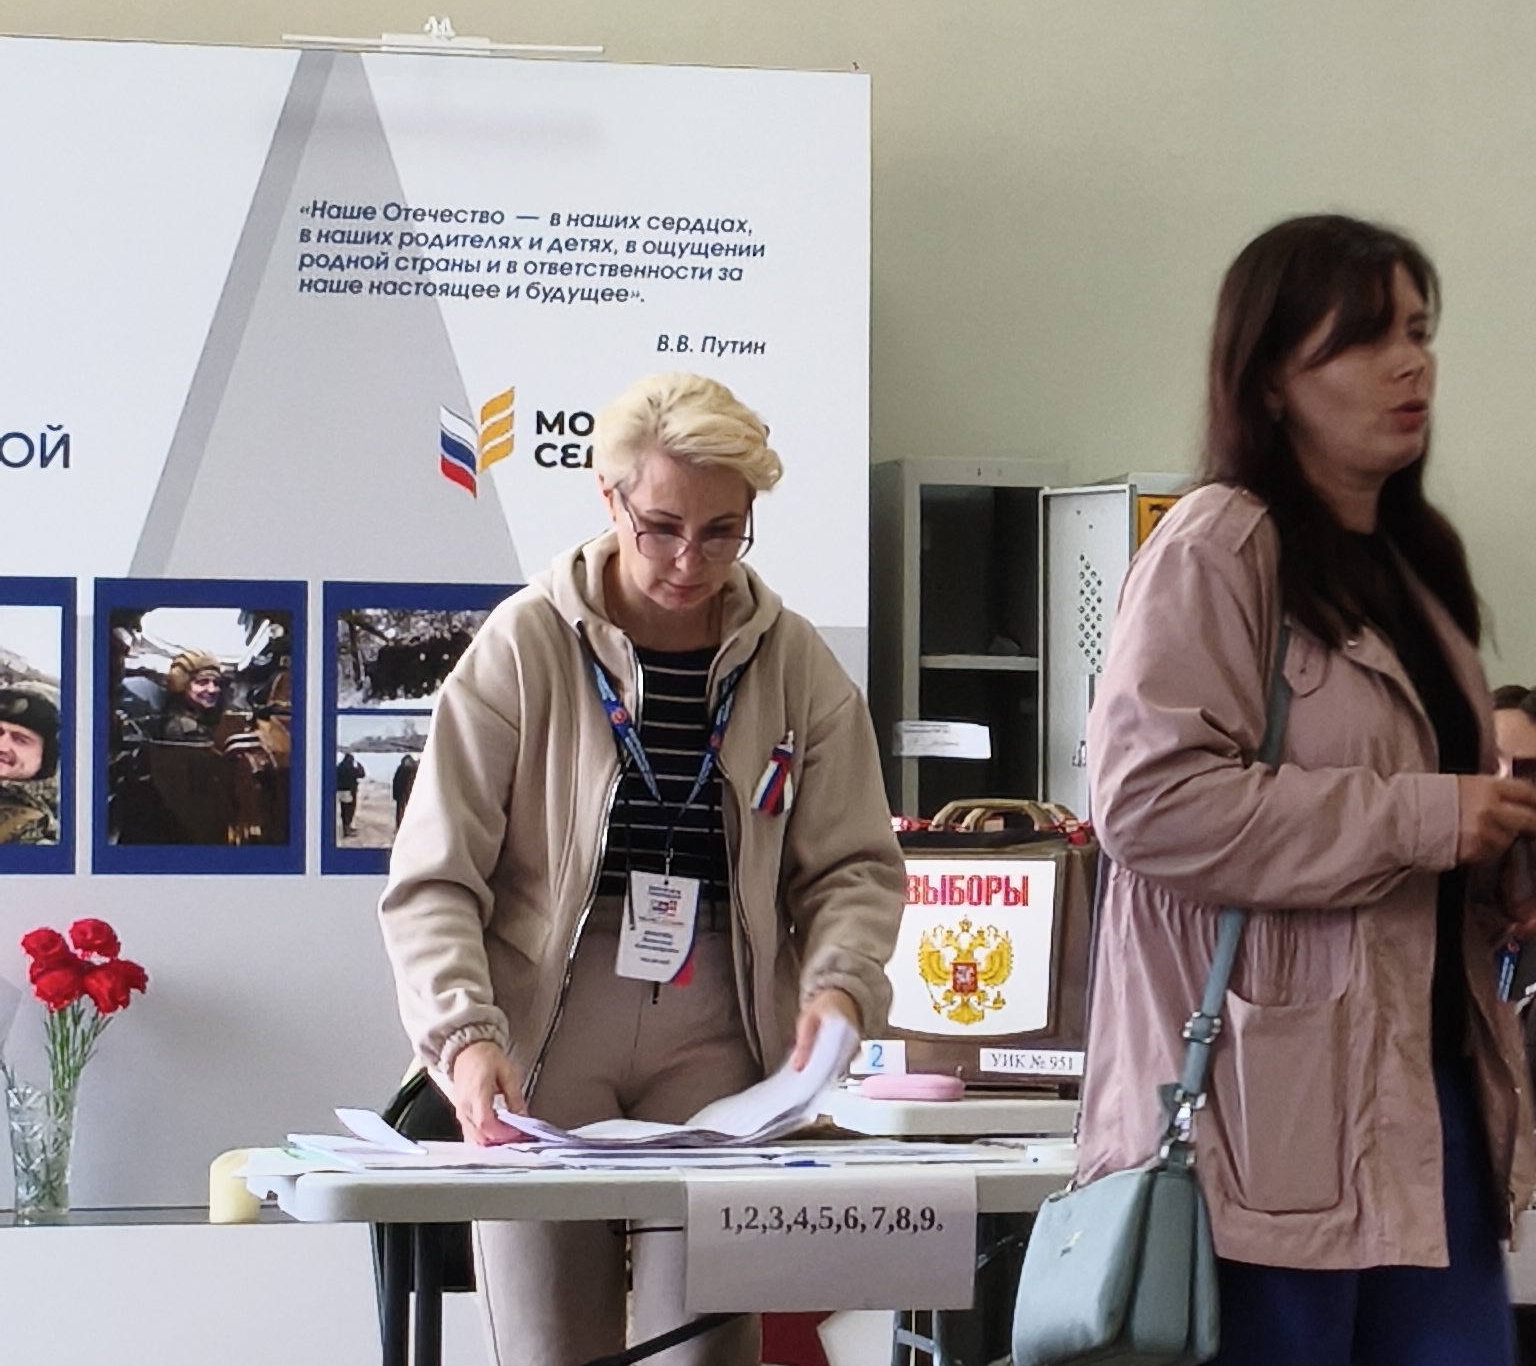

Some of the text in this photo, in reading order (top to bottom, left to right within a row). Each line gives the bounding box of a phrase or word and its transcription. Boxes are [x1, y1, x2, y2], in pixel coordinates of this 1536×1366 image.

[299, 199, 377, 221] «Наше
[382, 202, 505, 224] Отечество
[549, 212, 561, 227] в
[566, 213, 641, 229] наших
[646, 215, 752, 236] сердцах,
[299, 228, 766, 259] в наших родителях и детях, в ощущении
[298, 251, 743, 281] родной страны и в ответственности за
[298, 278, 645, 305] наше настоящее и будущее».
[656, 334, 767, 357] В.В. Путин
[905, 874, 1029, 907] ВЫБОРЫ
[871, 1043, 885, 1067] 2
[991, 1053, 1026, 1069] УИК
[1049, 1055, 1073, 1071] 951
